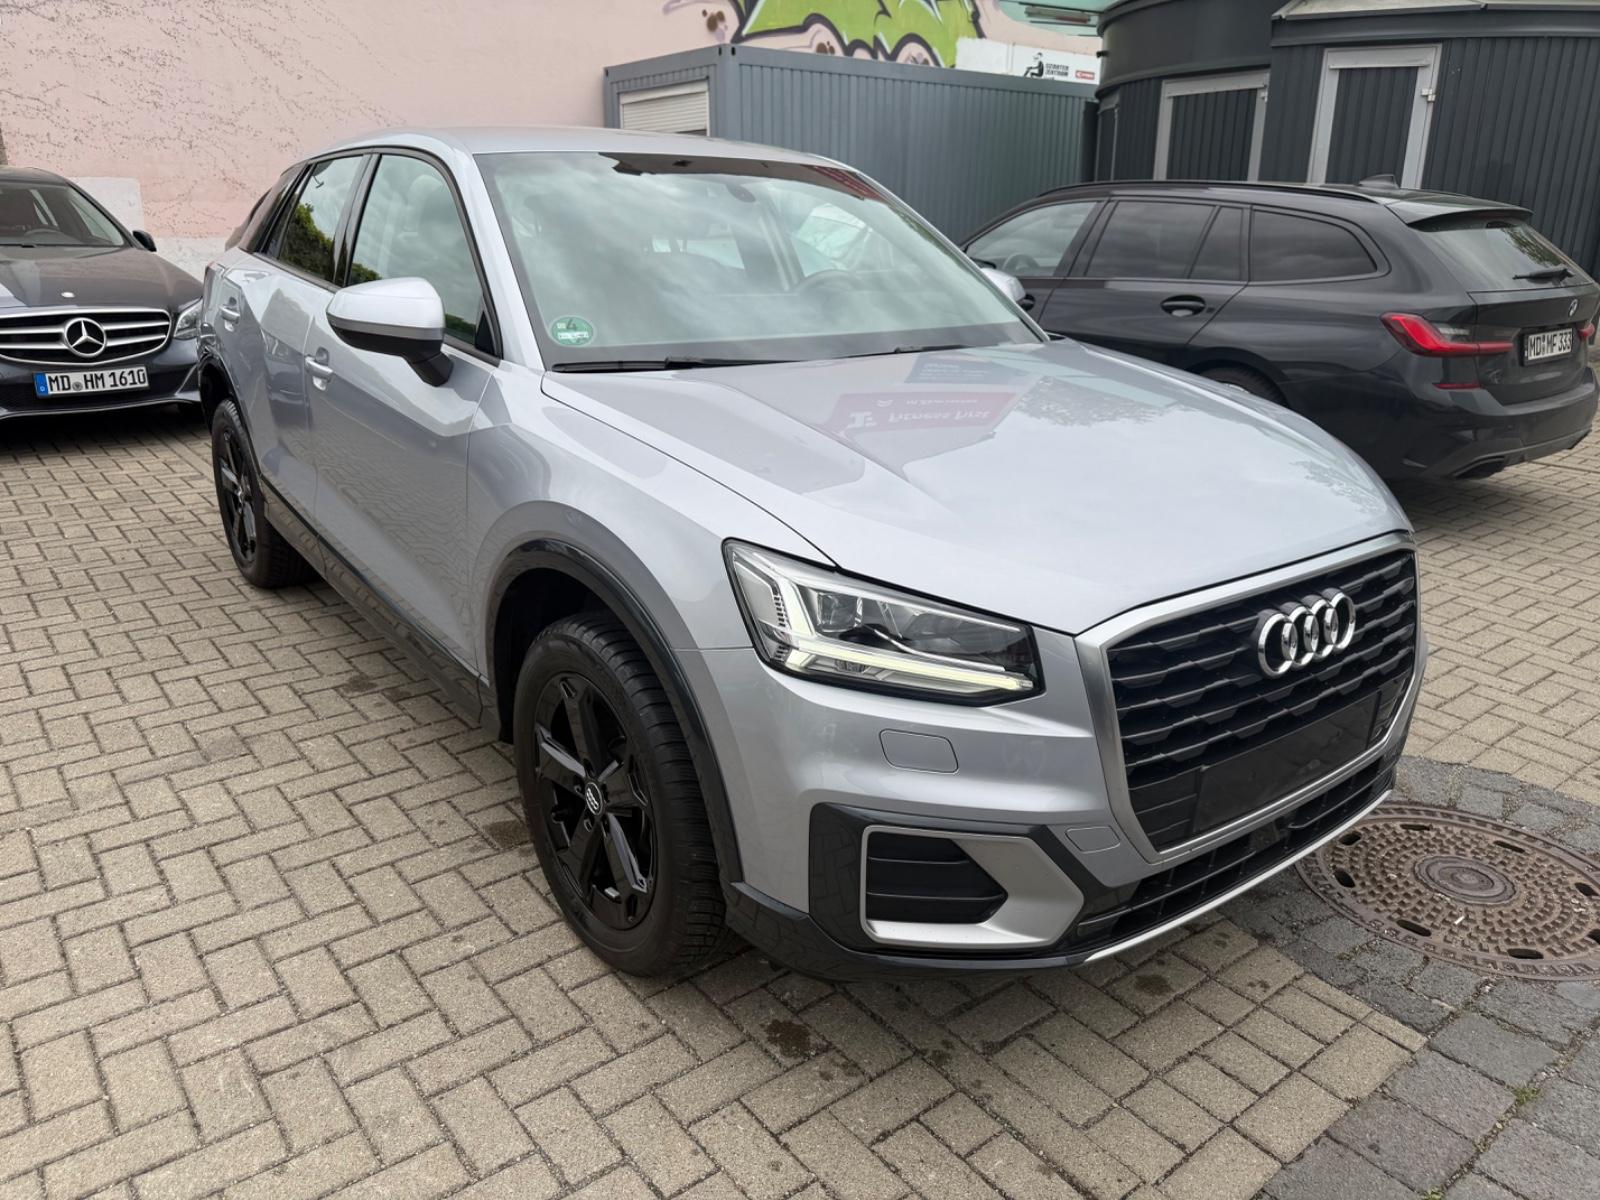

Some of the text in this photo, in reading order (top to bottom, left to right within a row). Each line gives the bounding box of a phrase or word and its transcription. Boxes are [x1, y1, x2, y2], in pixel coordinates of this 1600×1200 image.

[1529, 336, 1541, 357] MD
[1558, 331, 1572, 352] 333
[47, 369, 147, 391] MD HM 1610
